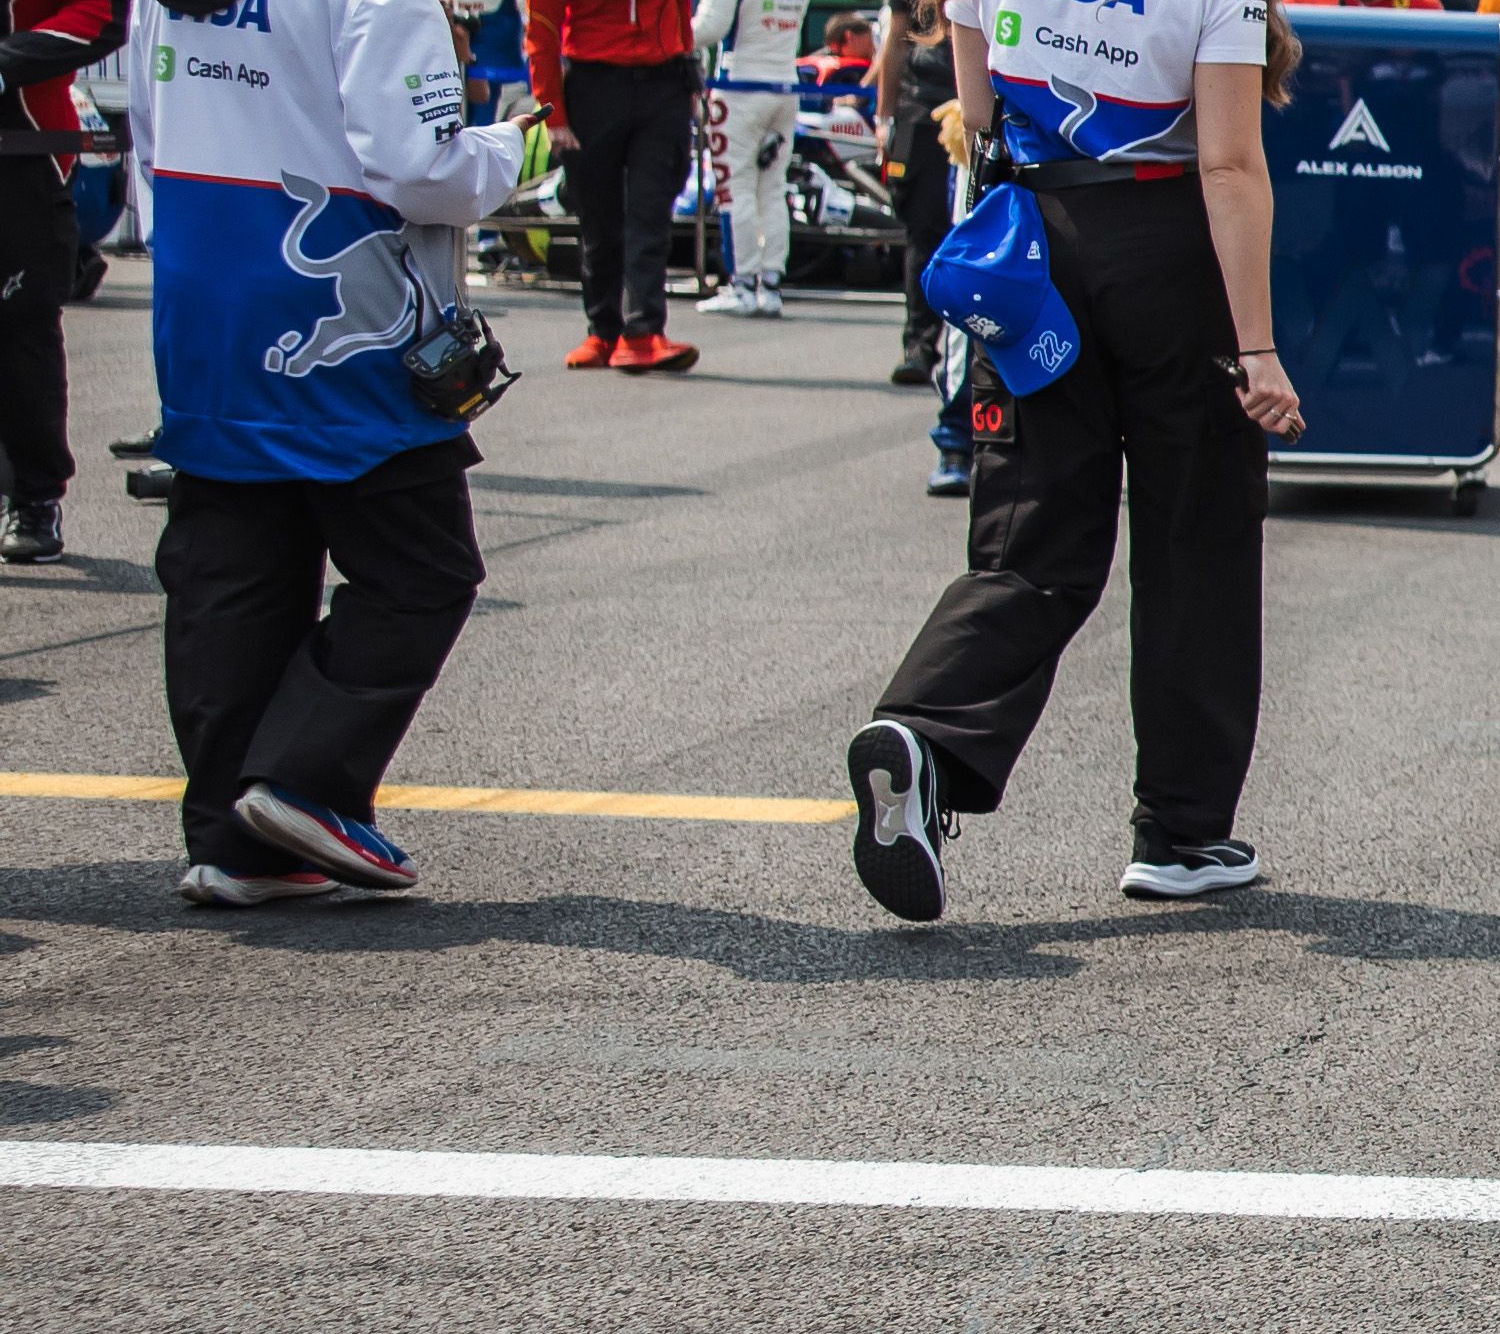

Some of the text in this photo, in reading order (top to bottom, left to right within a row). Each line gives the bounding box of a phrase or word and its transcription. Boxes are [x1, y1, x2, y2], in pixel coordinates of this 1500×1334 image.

[1035, 26, 1089, 55] Cash
[1094, 40, 1139, 67] App
[187, 56, 233, 81] Cash
[237, 63, 270, 90] App
[1297, 159, 1423, 179] ALEX ALBON
[972, 402, 1002, 432] GO
